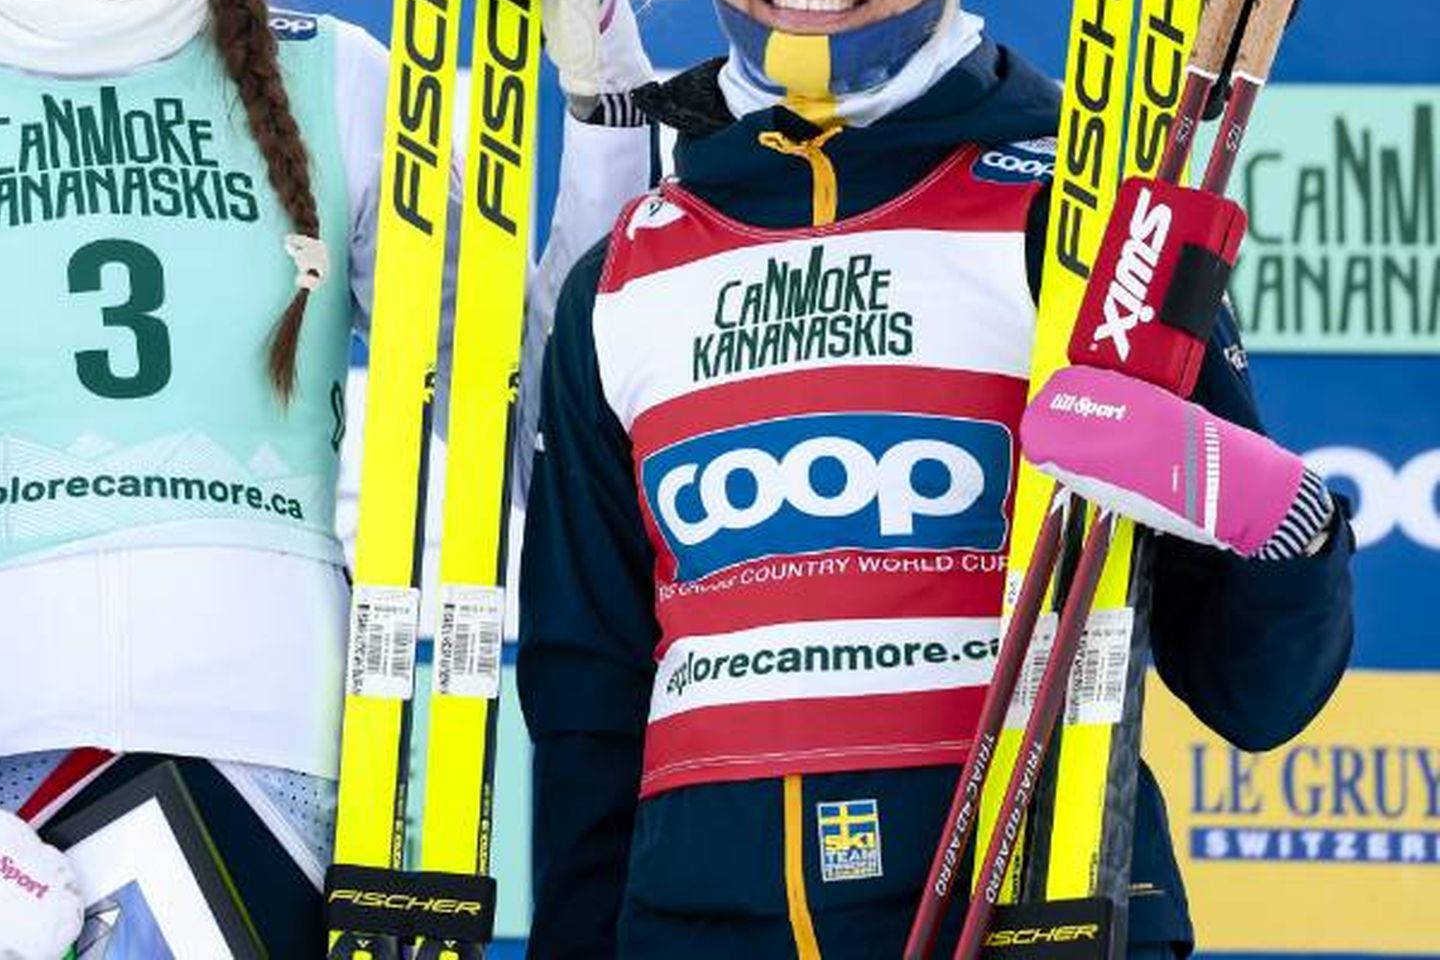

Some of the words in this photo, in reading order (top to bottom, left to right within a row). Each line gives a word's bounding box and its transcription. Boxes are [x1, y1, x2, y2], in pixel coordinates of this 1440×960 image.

[66, 238, 173, 400] 3
[715, 245, 892, 330] CANMORE
[693, 311, 914, 383] KANANASKIS
[658, 436, 985, 544] coop
[739, 554, 850, 586] COUNTRY
[858, 554, 953, 573] WORLD
[1190, 745, 1258, 815] LE
[1205, 829, 1440, 858] SWITZER
[328, 890, 482, 916] FISCHER
[984, 923, 1099, 947] ISCHER
